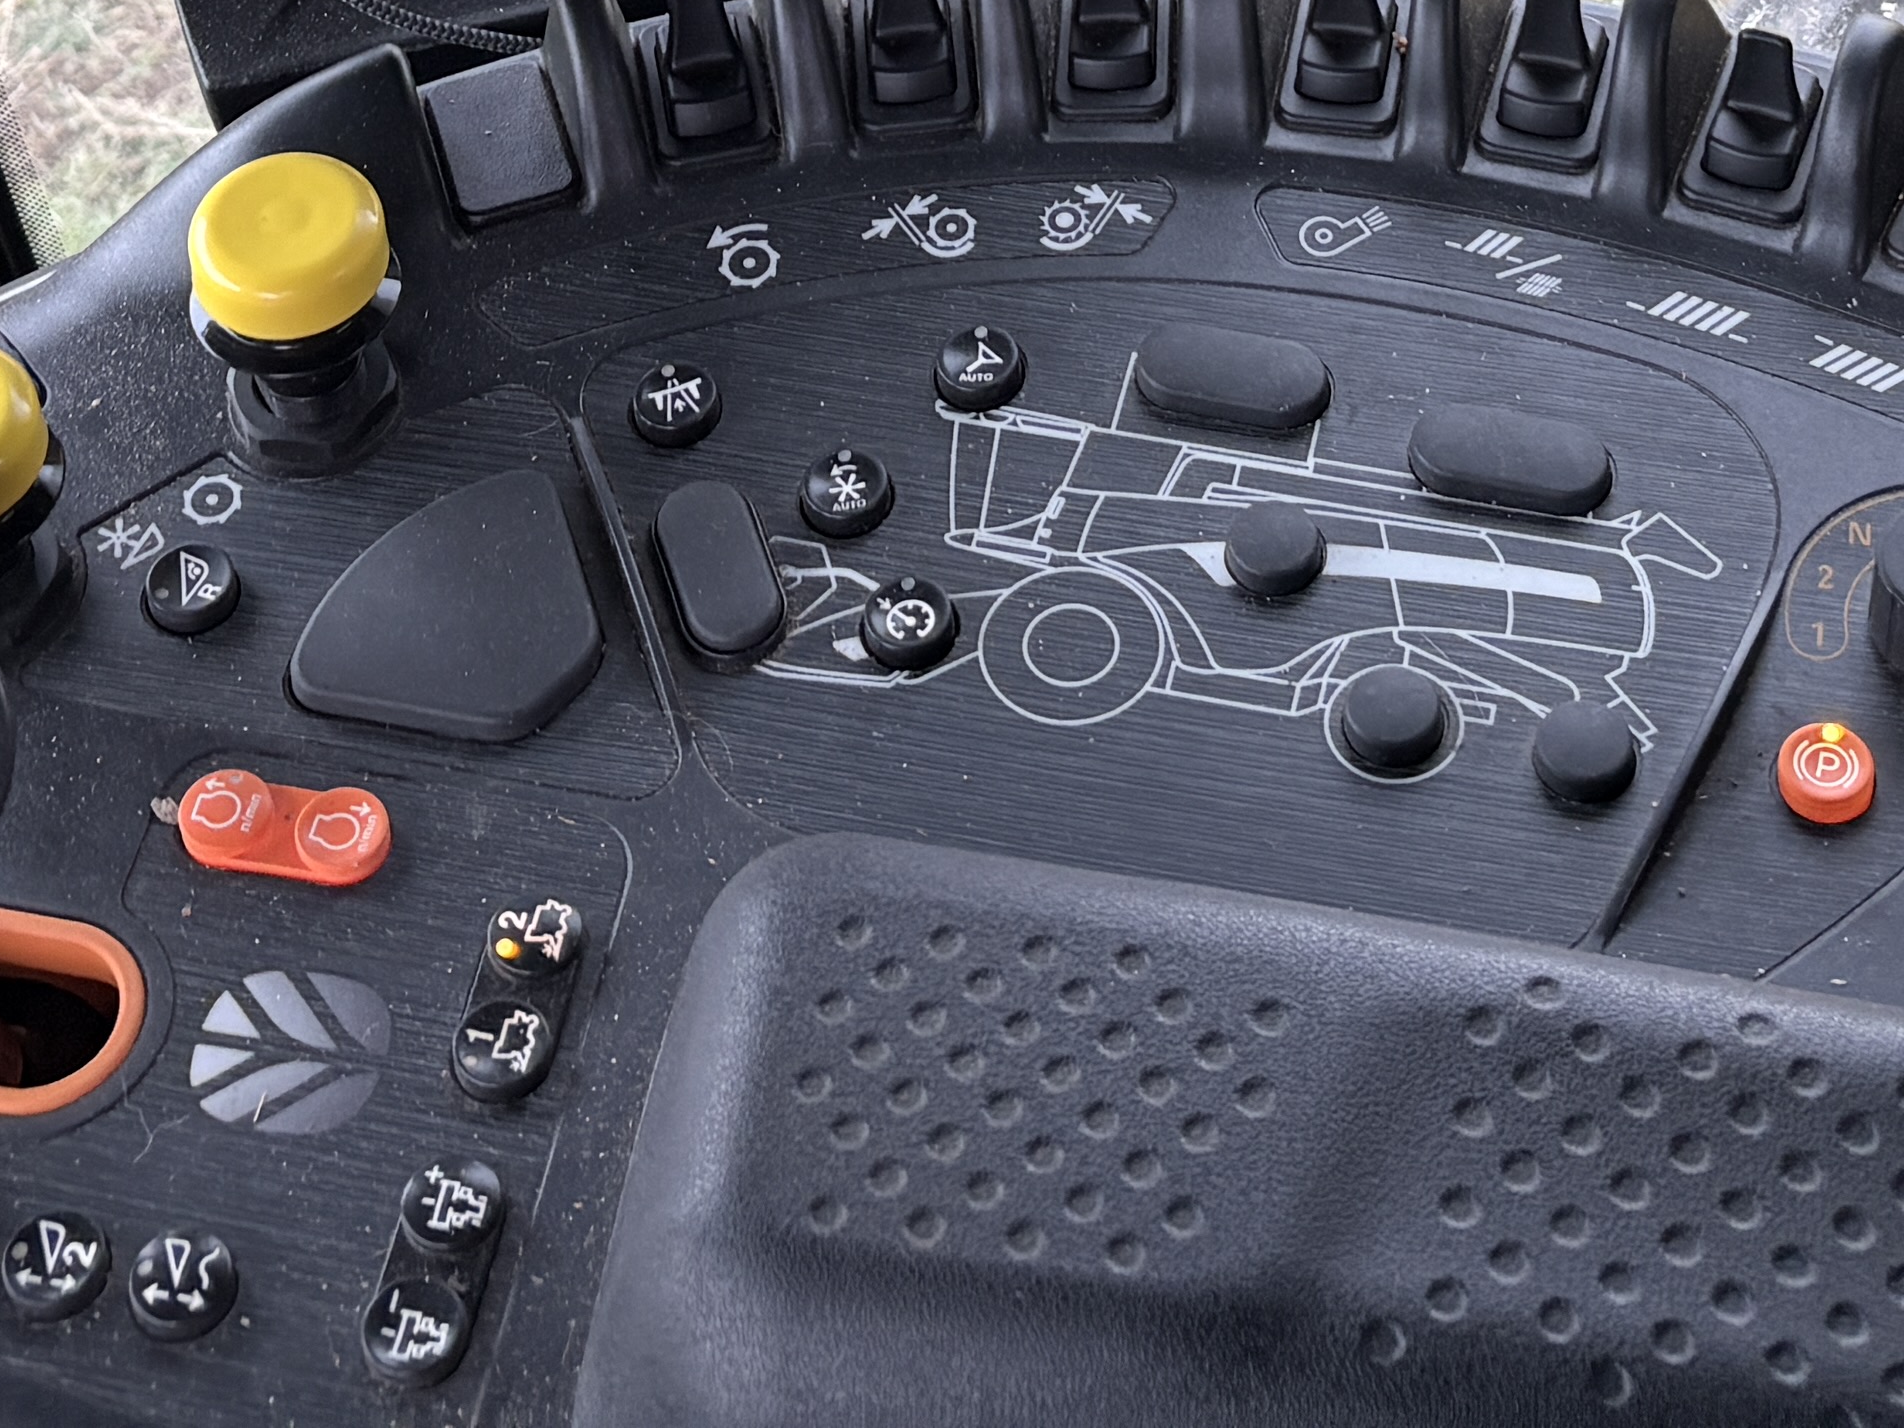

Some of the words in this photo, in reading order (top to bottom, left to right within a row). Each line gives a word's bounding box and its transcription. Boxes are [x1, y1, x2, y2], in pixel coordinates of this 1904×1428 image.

[958, 372, 994, 383] AUTO
[832, 498, 867, 512] AUTO
[1848, 521, 1872, 546] N
[1818, 564, 1835, 590] 2
[197, 582, 223, 601] R
[1811, 622, 1825, 647] 1
[1815, 751, 1841, 778] P
[239, 792, 263, 834] n/min
[356, 813, 379, 855] n/min
[498, 910, 528, 931] 2
[465, 1027, 495, 1043] 1
[62, 1240, 98, 1269] 2
